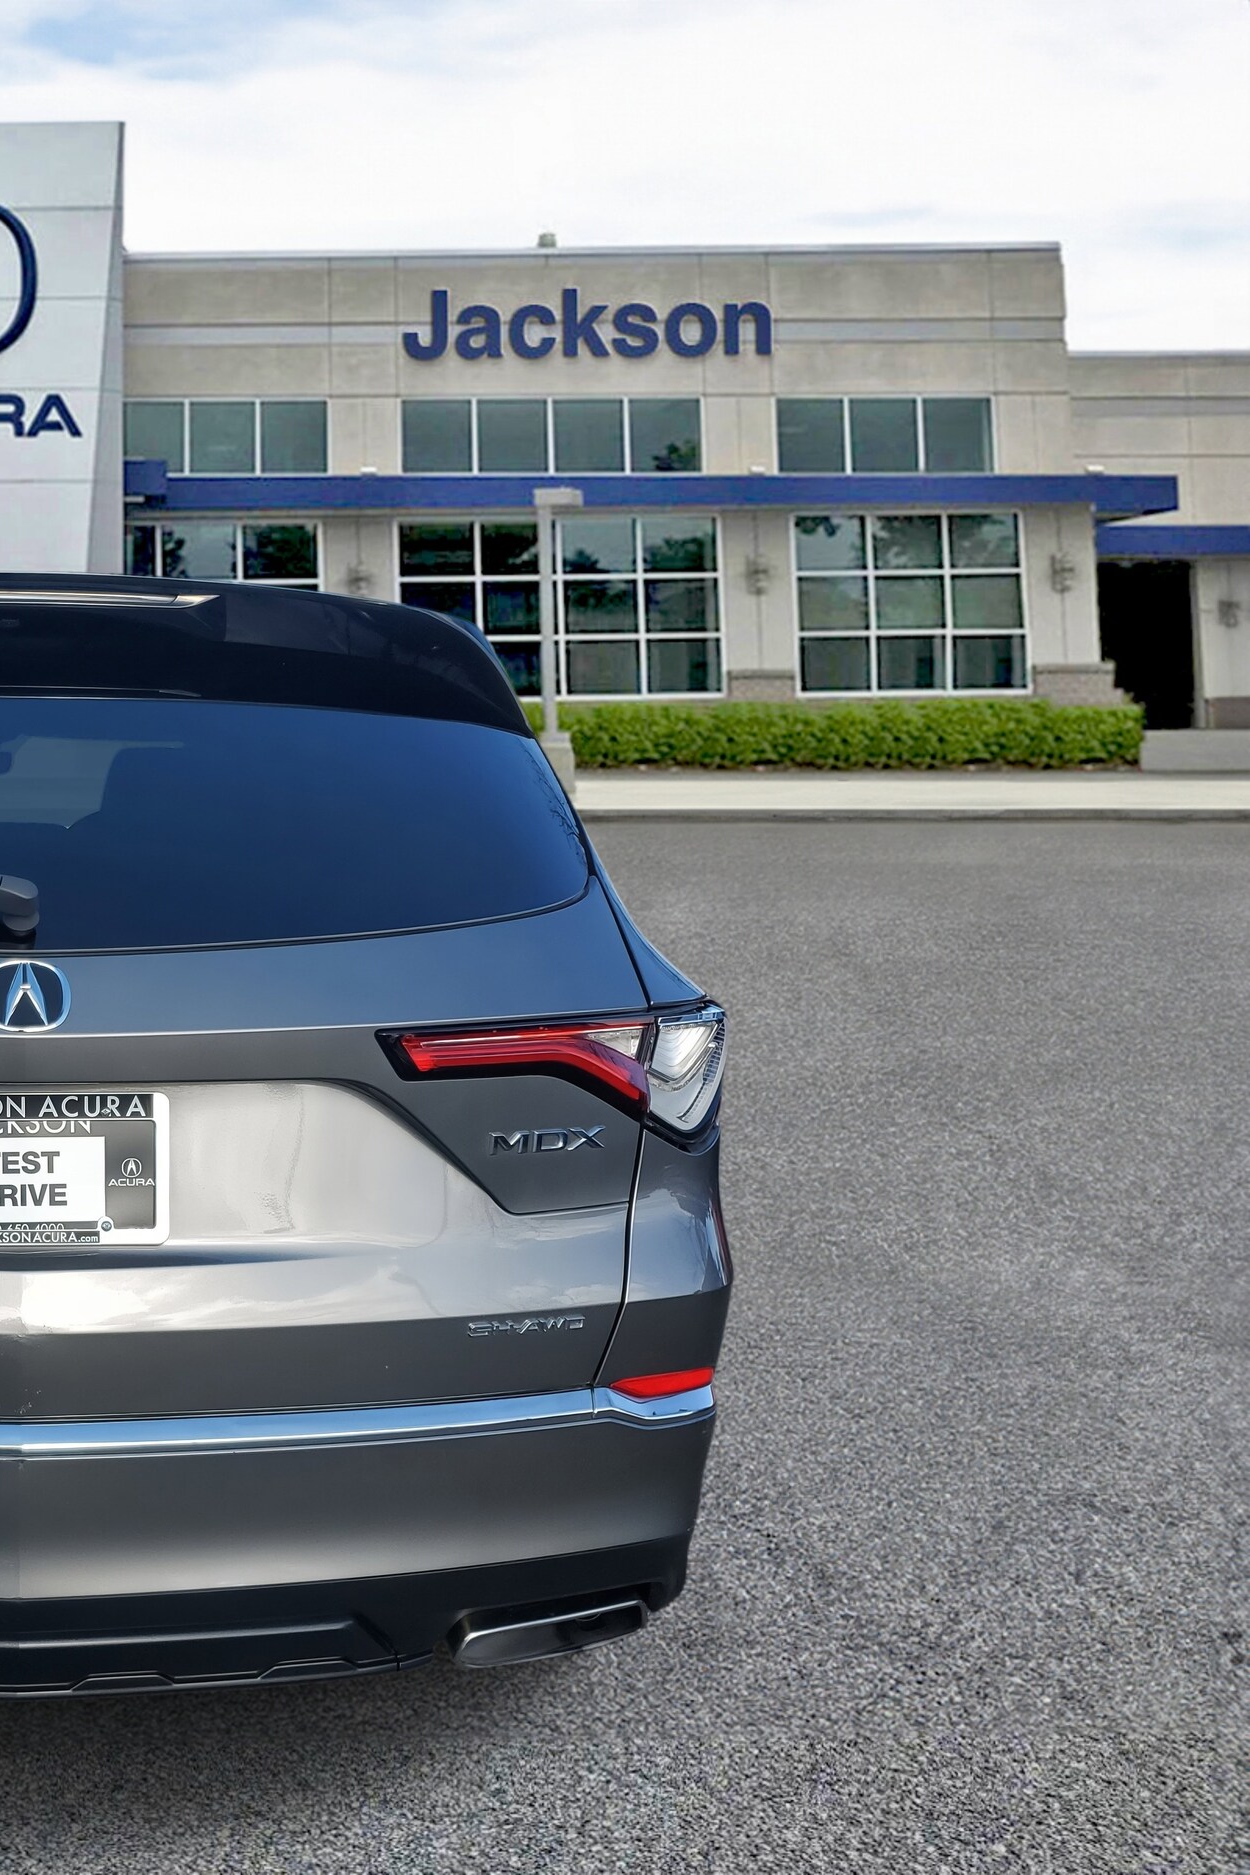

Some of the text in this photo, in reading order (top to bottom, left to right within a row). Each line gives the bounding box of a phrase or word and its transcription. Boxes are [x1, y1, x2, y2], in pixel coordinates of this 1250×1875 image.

[402, 288, 773, 361] Jackson
[38, 1095, 147, 1118] ACURA
[488, 1125, 606, 1156] MDX
[108, 1178, 155, 1187] ACURA
